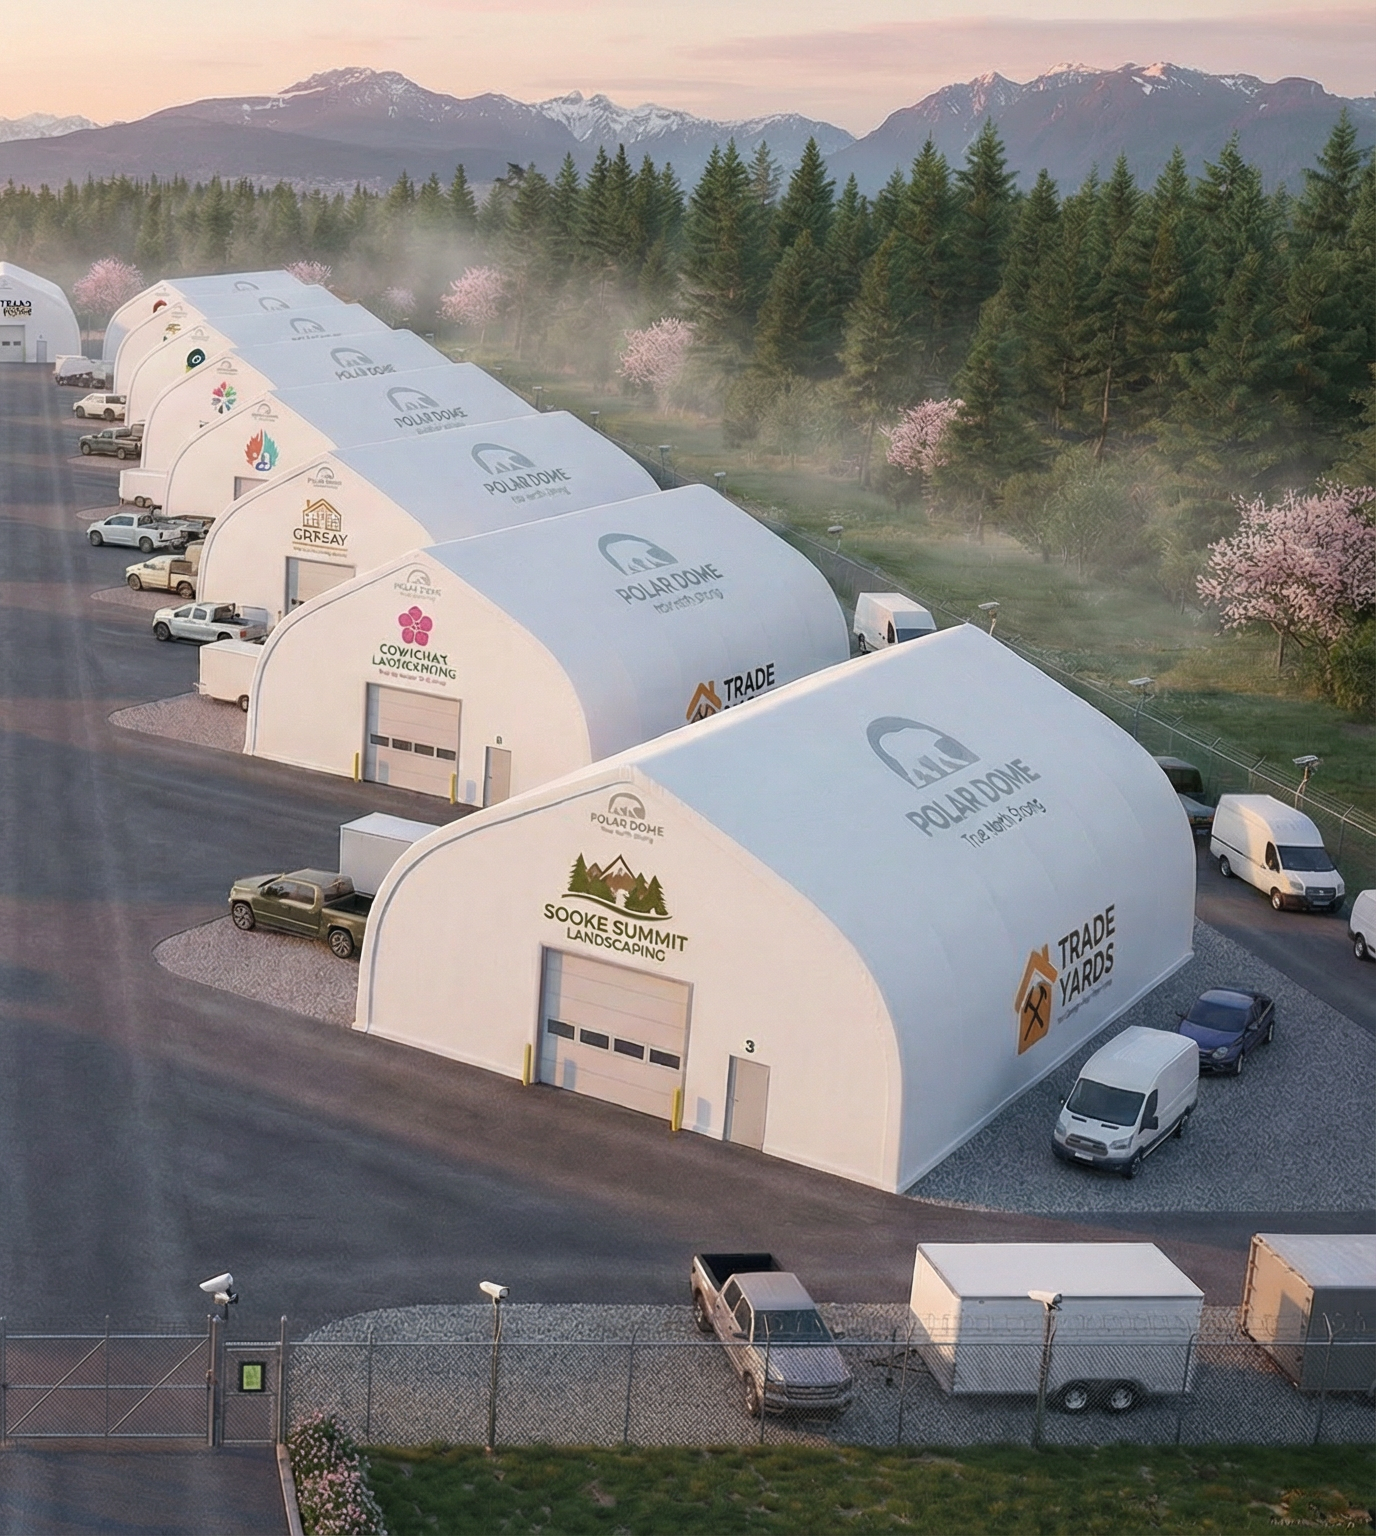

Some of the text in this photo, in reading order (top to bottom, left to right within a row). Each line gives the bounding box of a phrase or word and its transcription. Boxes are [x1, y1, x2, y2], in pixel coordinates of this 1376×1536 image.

[526, 468, 572, 487] DOME
[615, 577, 680, 605] POLAR
[670, 563, 724, 589] DOME
[723, 662, 775, 702] TRADE
[905, 758, 1042, 838] POLAR DOME
[590, 812, 627, 829] POLAR
[629, 820, 665, 837] DOME
[544, 903, 689, 952] SOOKE SUMMIT
[566, 926, 666, 962] LANDSCAPING
[1057, 903, 1116, 970] TRADE
[1059, 942, 1114, 1007] YARDS
[745, 1039, 755, 1054] 3
